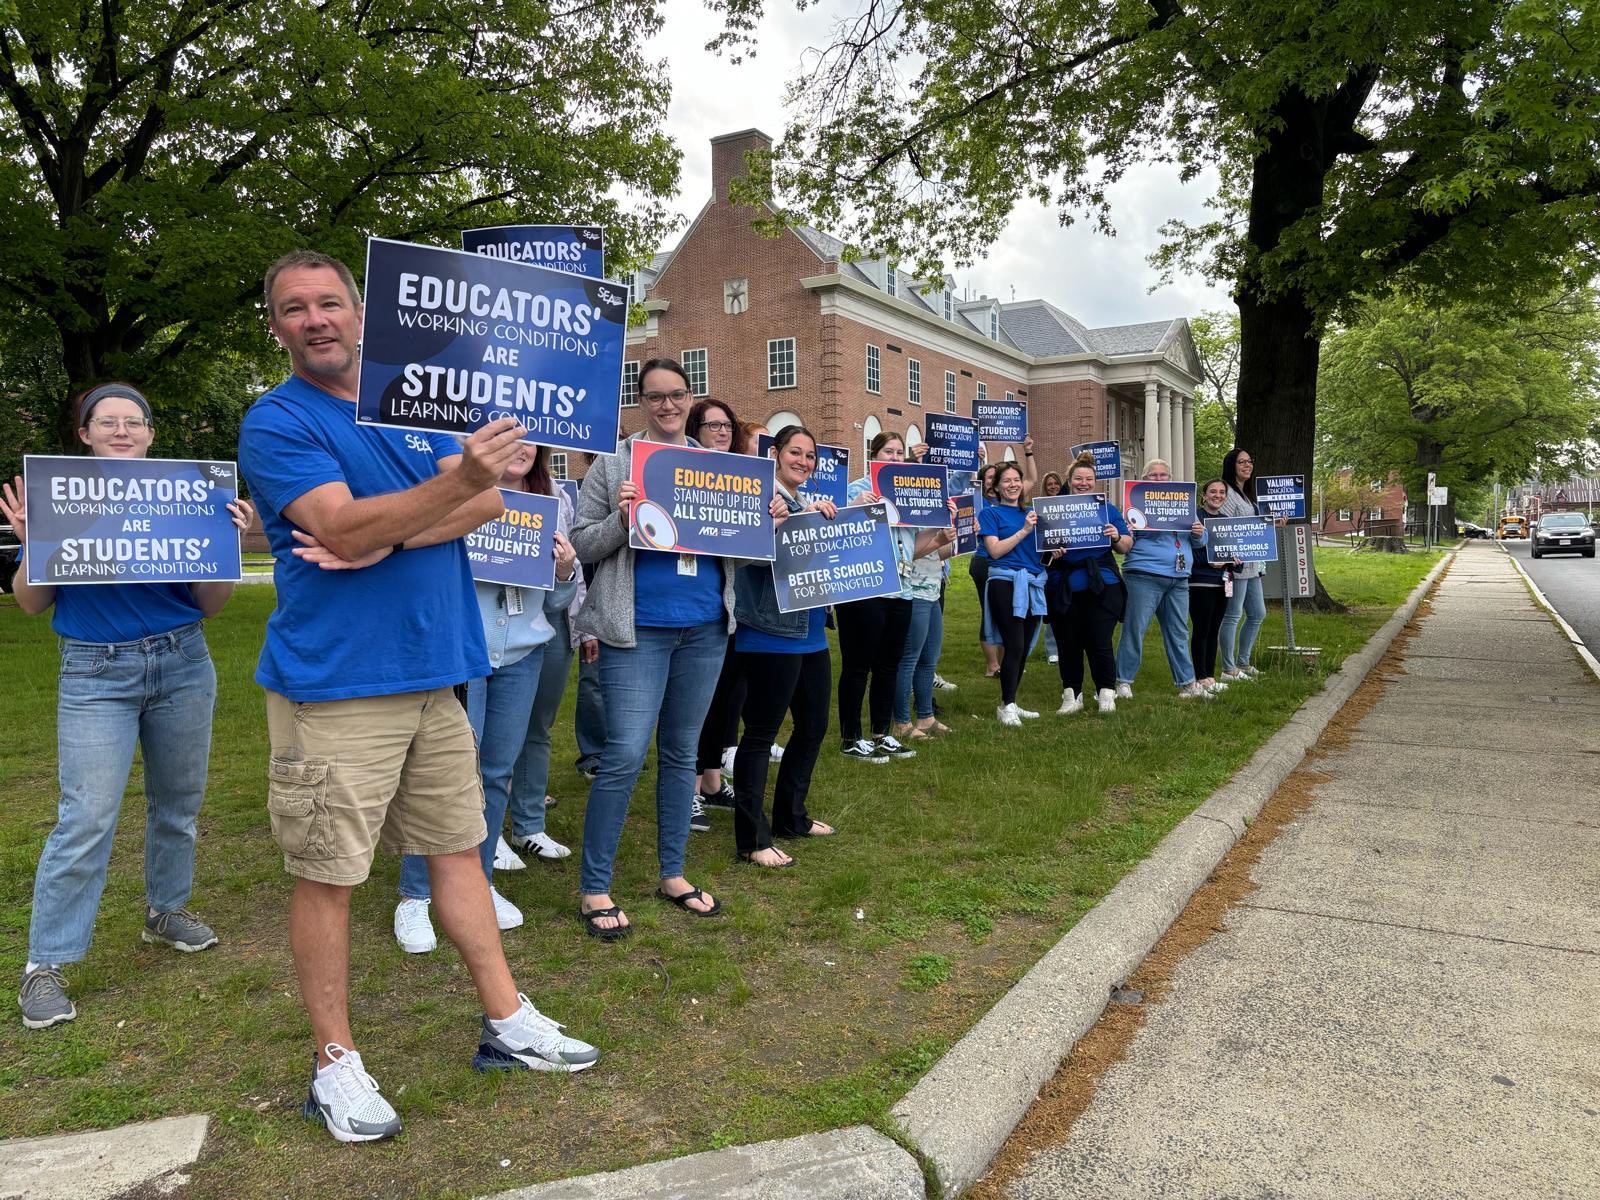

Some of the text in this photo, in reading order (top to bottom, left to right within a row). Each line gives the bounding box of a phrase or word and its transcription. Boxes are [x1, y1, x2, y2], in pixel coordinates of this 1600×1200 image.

[597, 287, 617, 304] SEA
[398, 272, 601, 336] EDUCATORS'
[397, 309, 599, 358] WORKING CONDITIONS
[482, 345, 519, 367] ARE
[401, 363, 587, 418] STUDENTS'
[391, 398, 482, 423] LEARNING
[978, 405, 1022, 415] EDUCATORS'
[931, 422, 974, 435] A FAIR CONTRACT
[979, 426, 1020, 435] STUDENTS'
[930, 447, 974, 459] BETTER SCHOOLS
[210, 466, 226, 477] SEA
[674, 467, 762, 496] EDUCATORS
[893, 475, 941, 489] EDUCATORS
[1266, 478, 1294, 488] VALUING
[51, 477, 215, 502] EDUCATORS'
[894, 487, 942, 498] STANDING UP FOR
[1144, 491, 1190, 501] EDUCATORS
[673, 487, 761, 511] STANDING UP FOR
[895, 497, 943, 508] ALL STUDENTS
[1144, 500, 1170, 508] STANDING
[1179, 501, 1190, 509] FOR
[52, 503, 216, 516] WORKING CONDITIONS
[1042, 502, 1100, 514] A FAIR CONTRACT
[1144, 507, 1190, 516] ALL STUDENTS
[1268, 501, 1296, 511] VALUING
[673, 503, 761, 526] ALL STUDENTS
[1047, 511, 1098, 521] FOR EDUCATORS
[122, 520, 151, 532] ARE
[698, 526, 718, 537] MTA
[782, 519, 877, 545] A FAIR CONTRACT
[1044, 526, 1102, 538] BETTER SCHOOLS
[1233, 523, 1267, 531] CONTRACT
[501, 525, 516, 539] UP
[519, 528, 541, 543] FOR
[1062, 534, 1100, 544] SPRINGFIELD
[61, 538, 210, 562] STUDENTS'
[466, 533, 540, 558] STUDENTS
[790, 534, 873, 557] FOR EDUCATORS
[1239, 543, 1269, 551] SCHOOLS
[1297, 528, 1308, 594] BUS STOP
[55, 561, 218, 577] LEARNING CONDITIONS
[788, 559, 885, 587] BETTER SCHOOLS
[794, 575, 883, 599] FOR SPRINGFIELD
